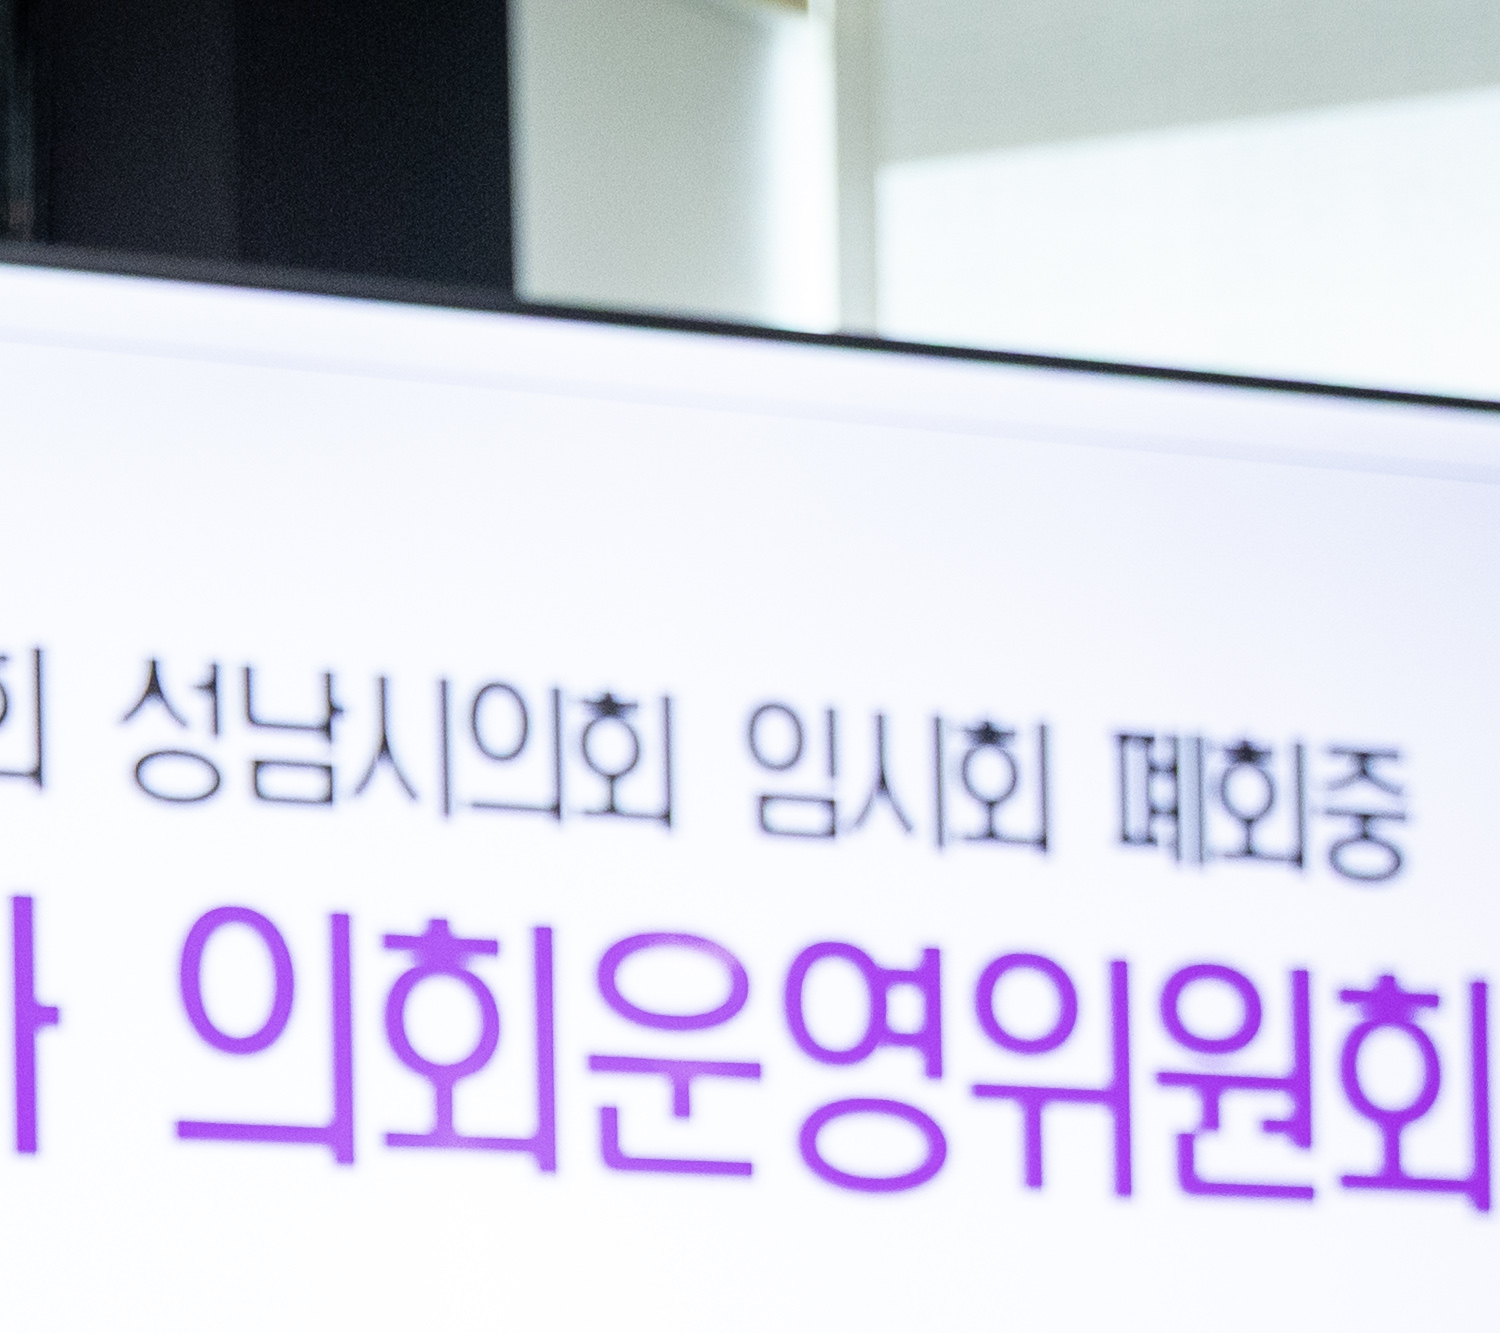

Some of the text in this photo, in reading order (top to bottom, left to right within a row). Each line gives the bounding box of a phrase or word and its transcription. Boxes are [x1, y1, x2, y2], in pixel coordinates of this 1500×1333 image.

[120, 655, 677, 831] 성남시의회
[743, 698, 1053, 857] 임시회
[1113, 729, 1409, 886] 폐회중
[173, 903, 1495, 1216] 의회운영위원회
